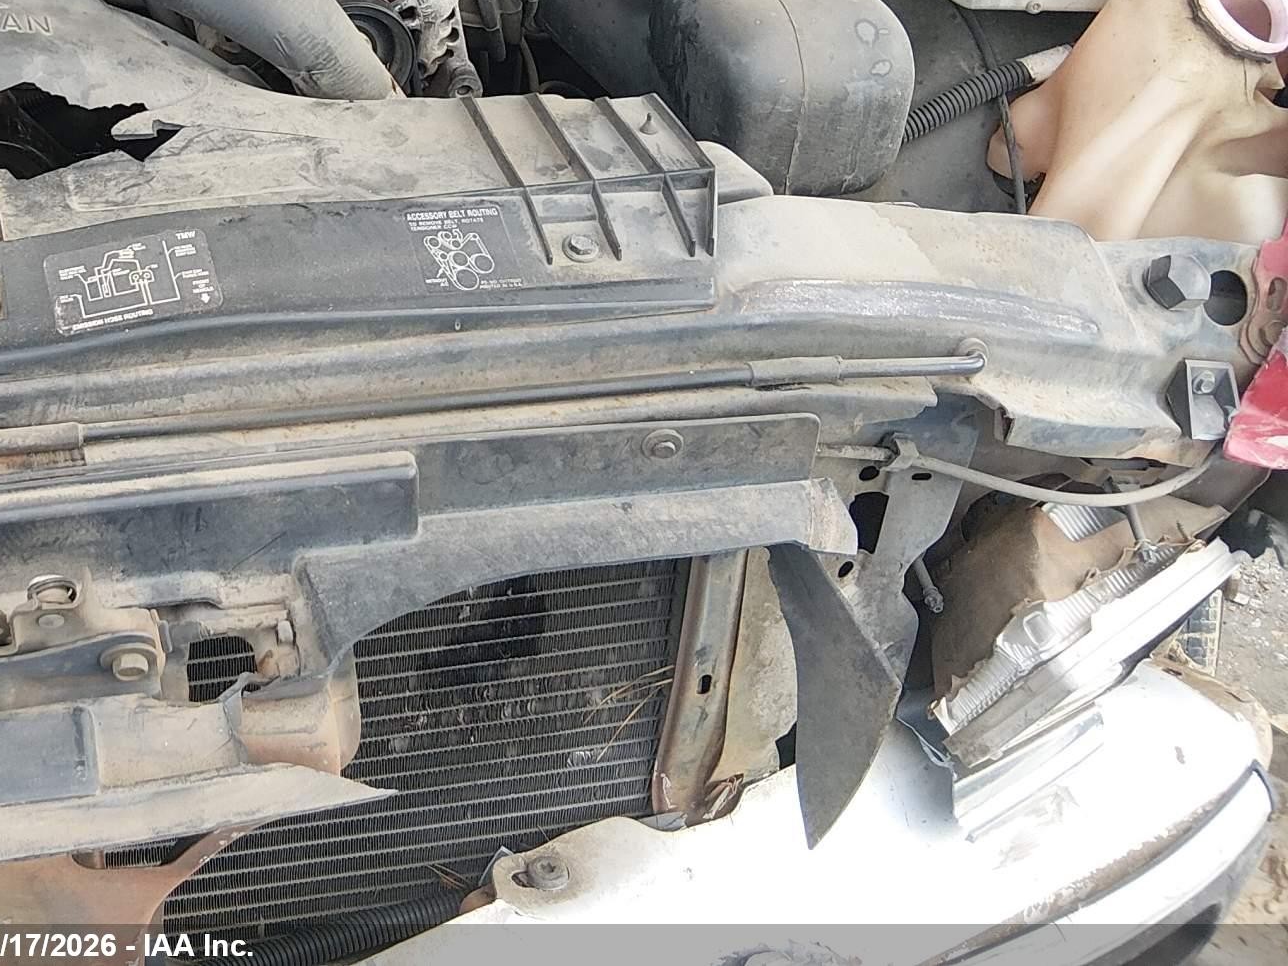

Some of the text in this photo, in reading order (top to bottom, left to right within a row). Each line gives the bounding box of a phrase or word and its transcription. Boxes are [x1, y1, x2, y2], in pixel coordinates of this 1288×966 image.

[407, 207, 498, 221] ACCESSORY BELT ROUTING
[123, 309, 154, 321] ROUTING
